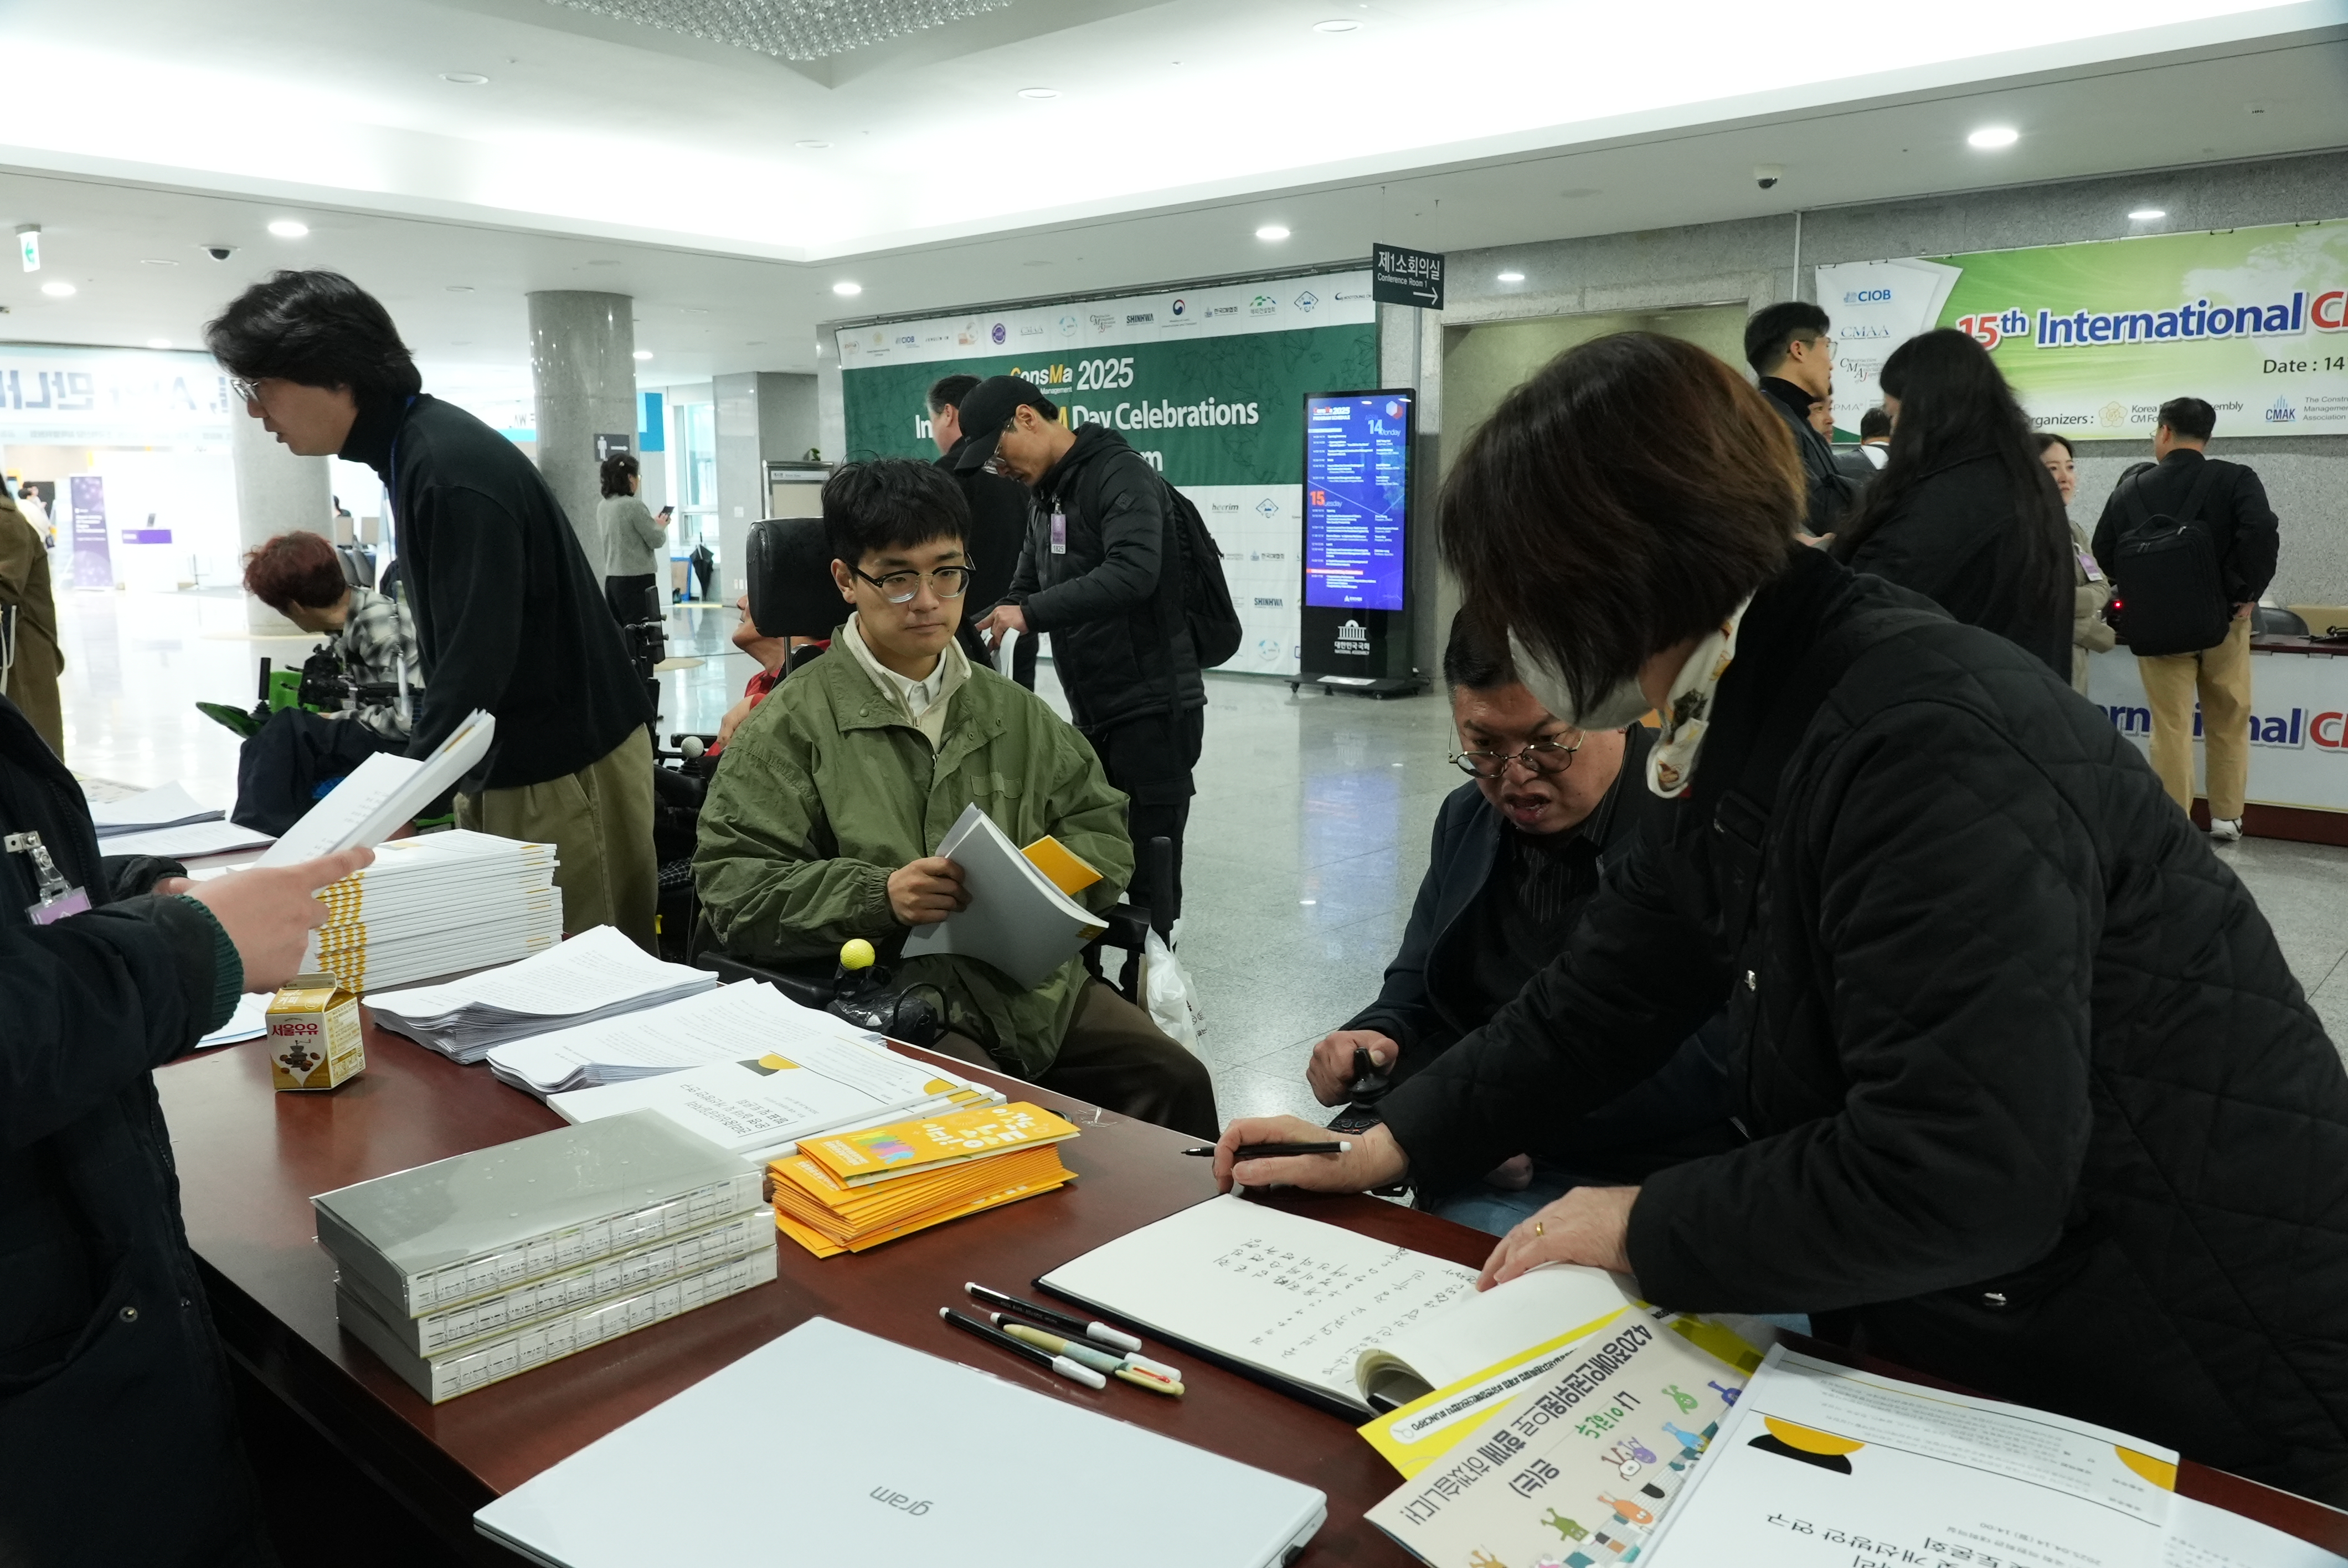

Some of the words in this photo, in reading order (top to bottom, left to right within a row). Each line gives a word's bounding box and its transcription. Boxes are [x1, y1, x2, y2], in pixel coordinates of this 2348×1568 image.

[1378, 251, 1440, 281] 제1소회의실
[1377, 272, 1408, 285] Conference
[1409, 277, 1423, 287] Room
[1858, 290, 1891, 302] CIOB
[1126, 313, 1154, 324] SHINHWA
[2038, 292, 2304, 344] International
[1841, 326, 1889, 338] CMAA
[1959, 310, 2026, 349] 15th
[1010, 364, 1073, 385] ConsMa
[1077, 357, 1134, 390] 2025
[2263, 359, 2307, 373] Date
[1041, 386, 1073, 395] Management
[1073, 405, 1111, 429] Day
[1115, 398, 1259, 430] Celebrations
[1333, 406, 1351, 415] 2025
[2132, 405, 2157, 413] Korea
[2265, 409, 2295, 420] CMAK
[1368, 419, 1383, 434] 14
[2030, 414, 2088, 428] rganizers
[2131, 415, 2146, 423] CM
[1310, 491, 1325, 506] 15
[1212, 503, 1239, 512] heerim
[1254, 597, 1283, 606] SHINHWA
[1334, 641, 1370, 650] 대한민국국회
[277, 996, 298, 1005] 커피
[271, 1023, 318, 1036] 서울우유
[1511, 1324, 1653, 1445] 420장애인권위원으로
[1613, 1391, 1641, 1411] 나
[1412, 1411, 1447, 1430] #UNCRPD
[1476, 1425, 1526, 1468] 함께
[1508, 1458, 1559, 1499] 은(는)
[1400, 1450, 1490, 1525] 하겠습니다!
[869, 1486, 934, 1516] gram
[1767, 1513, 1814, 1535] 연구
[1822, 1528, 1927, 1566] 개선방안
[1923, 1537, 2002, 1568] 토론회
